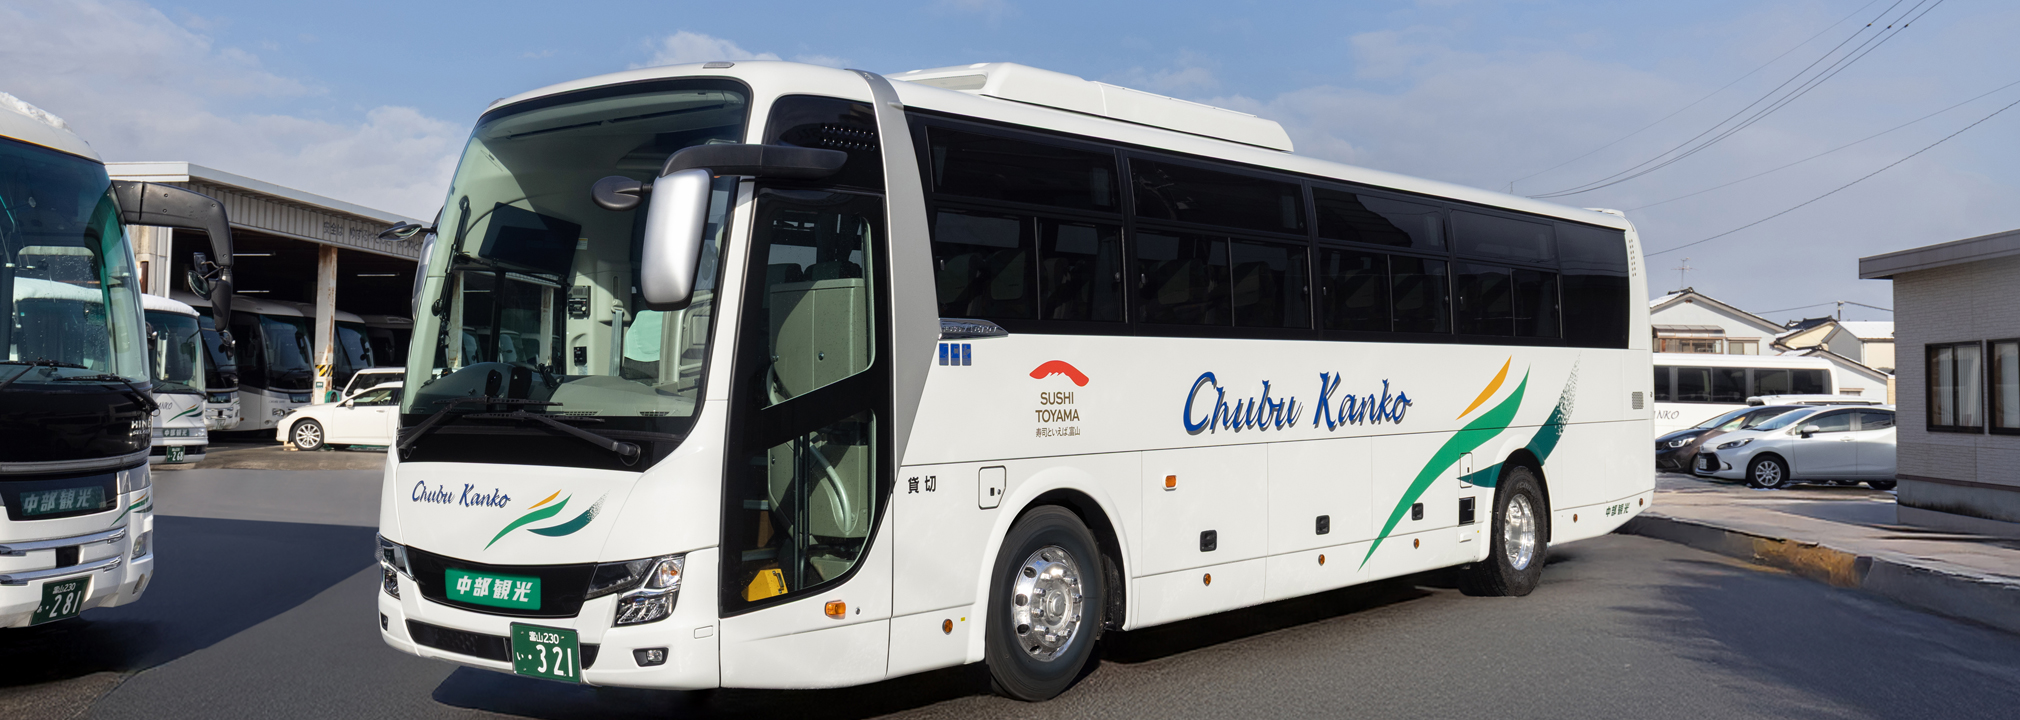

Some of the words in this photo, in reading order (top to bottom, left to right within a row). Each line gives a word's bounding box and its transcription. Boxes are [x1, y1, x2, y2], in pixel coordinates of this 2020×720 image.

[1040, 391, 1074, 405] SUSHI
[1183, 371, 1303, 436] Chubu
[1312, 371, 1413, 432] Kanko
[1035, 408, 1080, 423] TOYAMA
[23, 488, 92, 513] 中部観光
[411, 480, 455, 504] Chubu
[459, 483, 511, 508] Kanko
[456, 575, 533, 602] 中部観光
